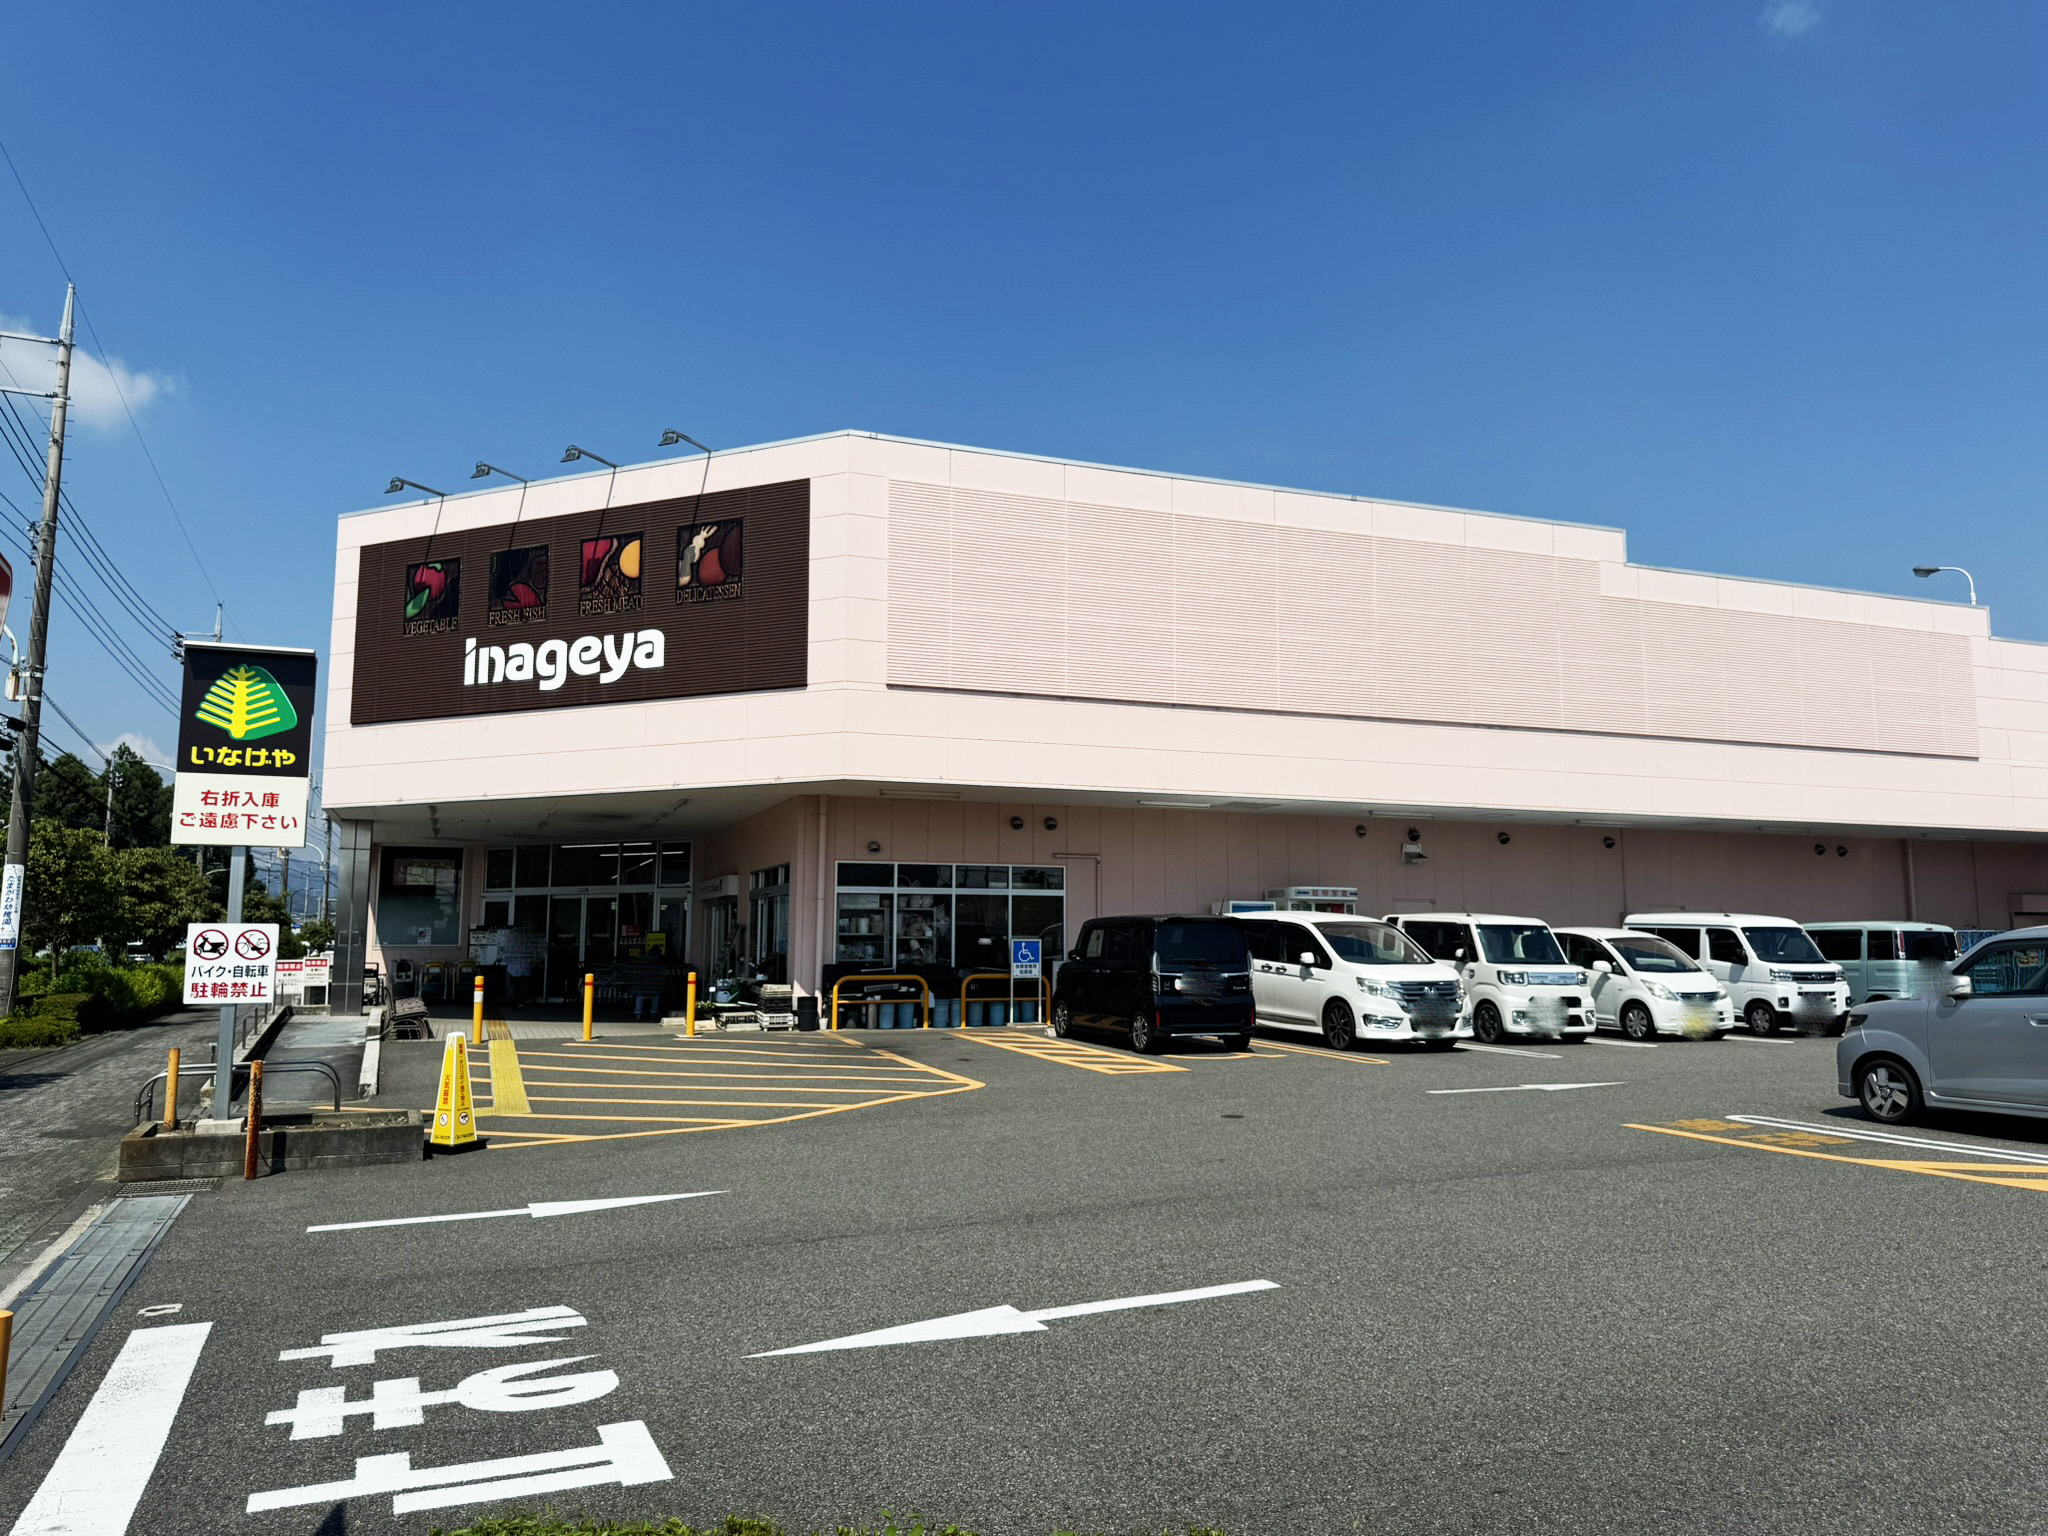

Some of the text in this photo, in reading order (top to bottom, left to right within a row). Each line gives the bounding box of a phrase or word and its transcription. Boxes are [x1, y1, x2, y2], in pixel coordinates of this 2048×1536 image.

[676, 582, 742, 604] DELICATESSEN
[488, 605, 546, 626] FRESH FISH
[579, 598, 611, 615] FRESH
[404, 616, 458, 635] VEGETABLE
[464, 628, 665, 691] inageya
[191, 746, 296, 768] いなげや
[201, 790, 280, 808] 右折入庫
[180, 812, 298, 830] ご遠慮下さい
[191, 965, 269, 978] バイク・自転車
[190, 982, 268, 999] 駐輪禁止
[246, 1305, 675, 1517] 止まれ
